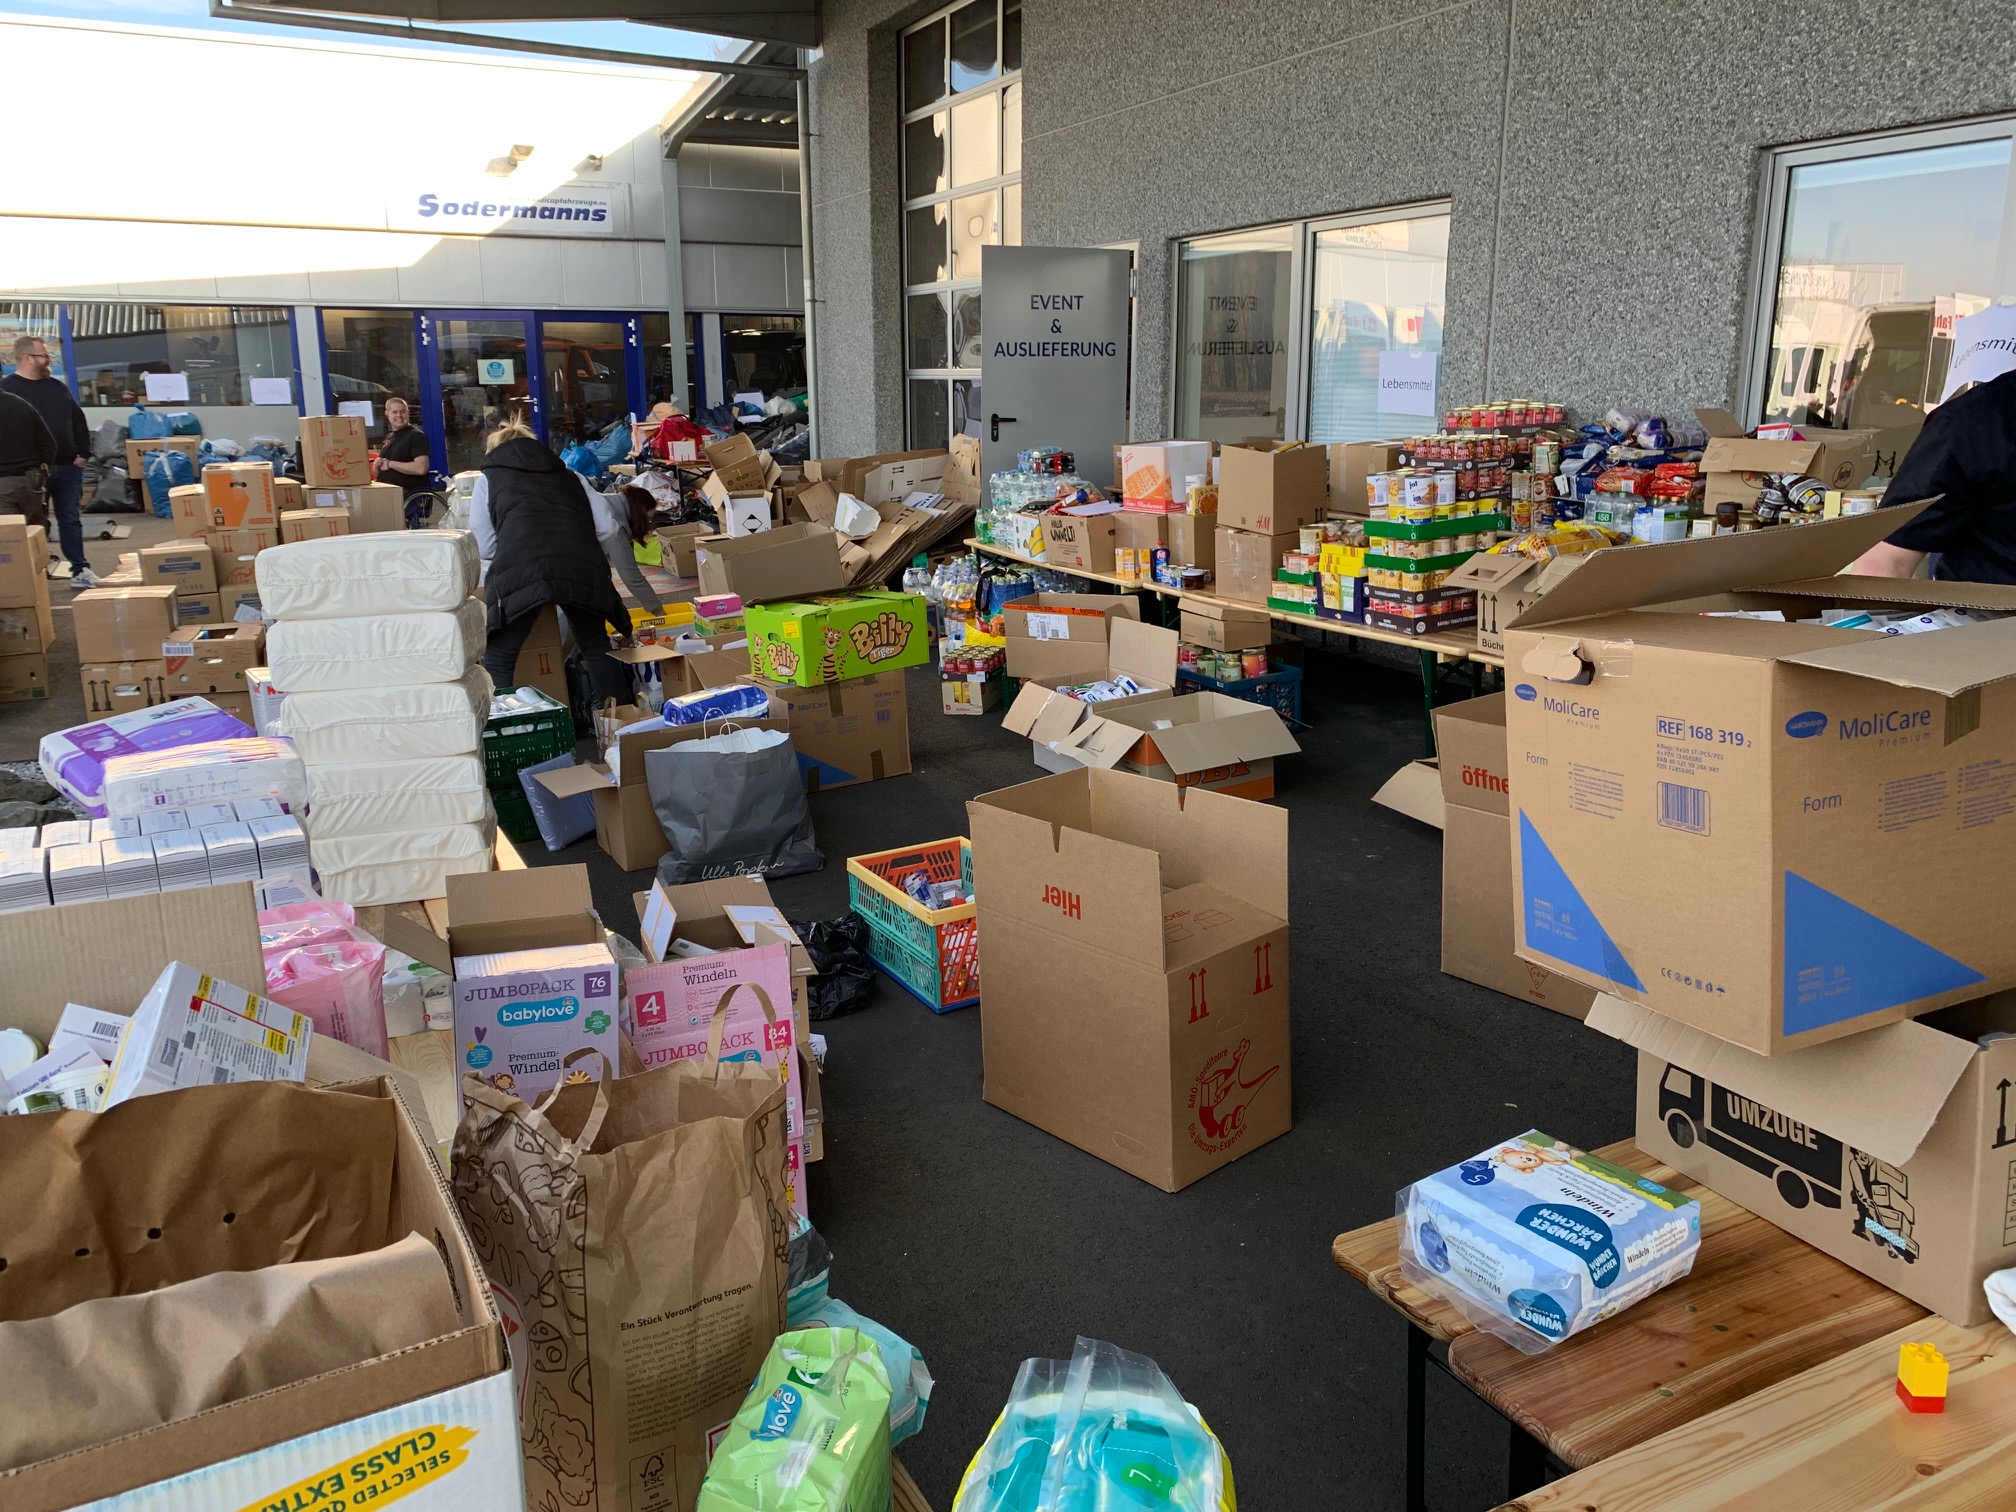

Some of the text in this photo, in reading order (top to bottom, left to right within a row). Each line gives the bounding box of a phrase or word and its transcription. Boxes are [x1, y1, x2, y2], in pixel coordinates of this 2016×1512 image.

[418, 194, 607, 222] Sodermanns
[1030, 295, 1083, 310] EVENT
[1050, 318, 1062, 334] &
[994, 341, 1116, 357] AUSLIEFERUNG
[1382, 377, 1433, 392] Lebensmittel
[849, 611, 914, 659] Billy
[766, 642, 800, 670] Billy
[872, 647, 895, 659] Tiger
[798, 702, 829, 711] MoliCare
[1544, 697, 1600, 720] MoliCare
[1566, 718, 1600, 730] Premium
[1659, 719, 1752, 748] REF 168 319 2
[1839, 709, 1931, 741] MoliCare
[1879, 732, 1931, 748] Premium
[1526, 752, 1548, 767] Form
[1803, 794, 1843, 813] Form
[702, 864, 730, 881] Ulla
[1042, 884, 1082, 921] Hier
[267, 967, 286, 982] 4
[683, 961, 727, 974] Premium-
[588, 976, 606, 988] 76
[683, 969, 738, 986] Windeln
[465, 979, 575, 1002] JUMBOPACK
[502, 1003, 575, 1022] babylove
[642, 995, 661, 1015] 4
[768, 1026, 788, 1040] 84
[508, 1050, 559, 1062] Premium-
[644, 1032, 755, 1066] JUMBOACK
[509, 1059, 571, 1076] Windel
[16, 1081, 39, 1096] Calcium
[1187, 1049, 1228, 1110] AMÖ-Spediteure
[1194, 1123, 1249, 1156] Umzugs-Experten
[1559, 1187, 1616, 1218] Windeln
[1529, 1216, 1593, 1250] WUNDER
[1537, 1208, 1604, 1242] BÄRCHEN
[1588, 1248, 1614, 1271] WUNDER
[1626, 1247, 1650, 1264] Windeln
[1464, 1267, 1502, 1295] Windeln
[621, 1283, 754, 1331] Ein Stück Verantwortung tragen.
[1518, 1308, 1564, 1333] WUNDER
[768, 1391, 796, 1437] love
[350, 1430, 436, 1483] CLASS
[352, 1449, 452, 1505] SELECTED
[643, 1474, 664, 1487] FSC
